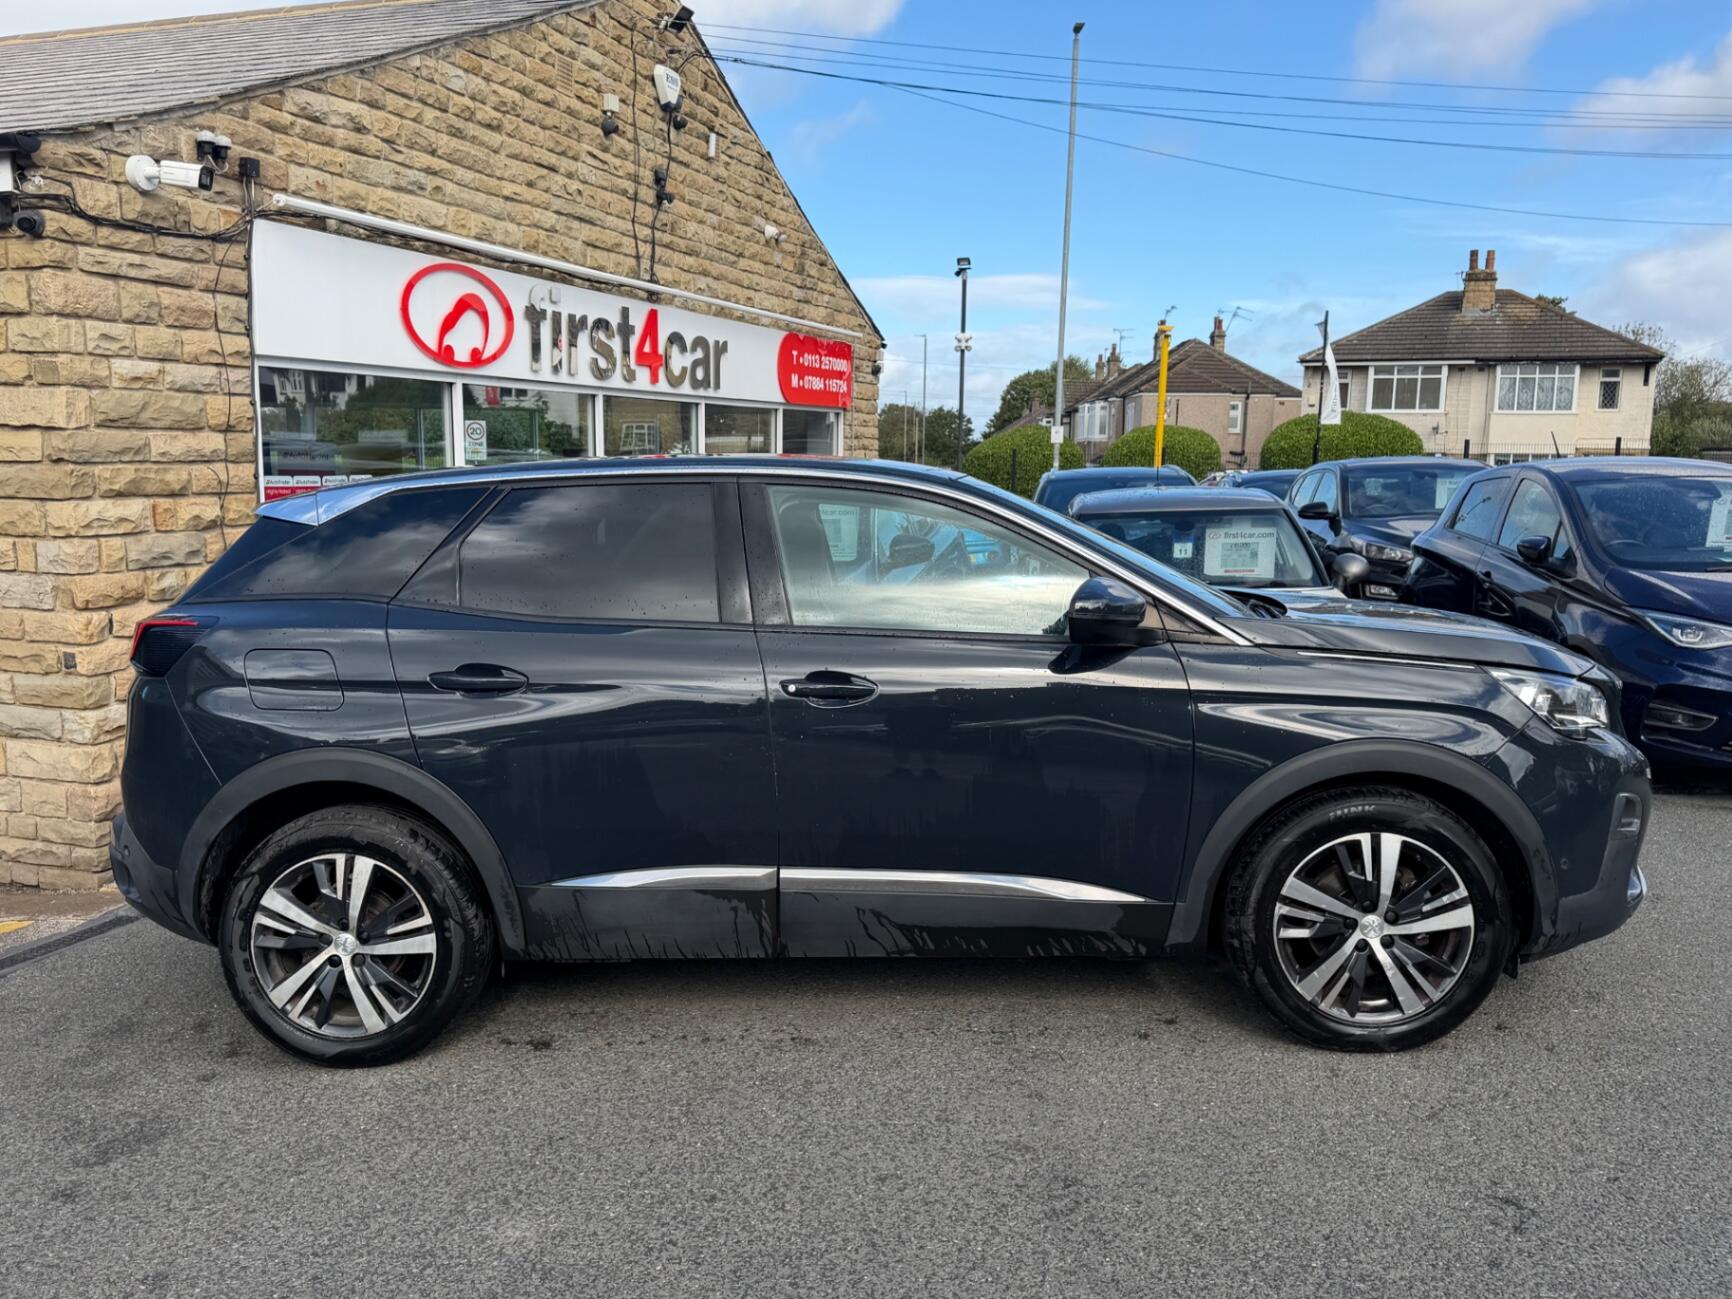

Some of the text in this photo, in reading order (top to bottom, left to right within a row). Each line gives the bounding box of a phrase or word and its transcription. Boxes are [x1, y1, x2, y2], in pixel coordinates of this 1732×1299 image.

[524, 284, 729, 392] first4car
[791, 350, 798, 365] T
[803, 352, 820, 369] 0113
[791, 373, 799, 389] M
[803, 375, 824, 391] 07884
[469, 426, 482, 436] 20
